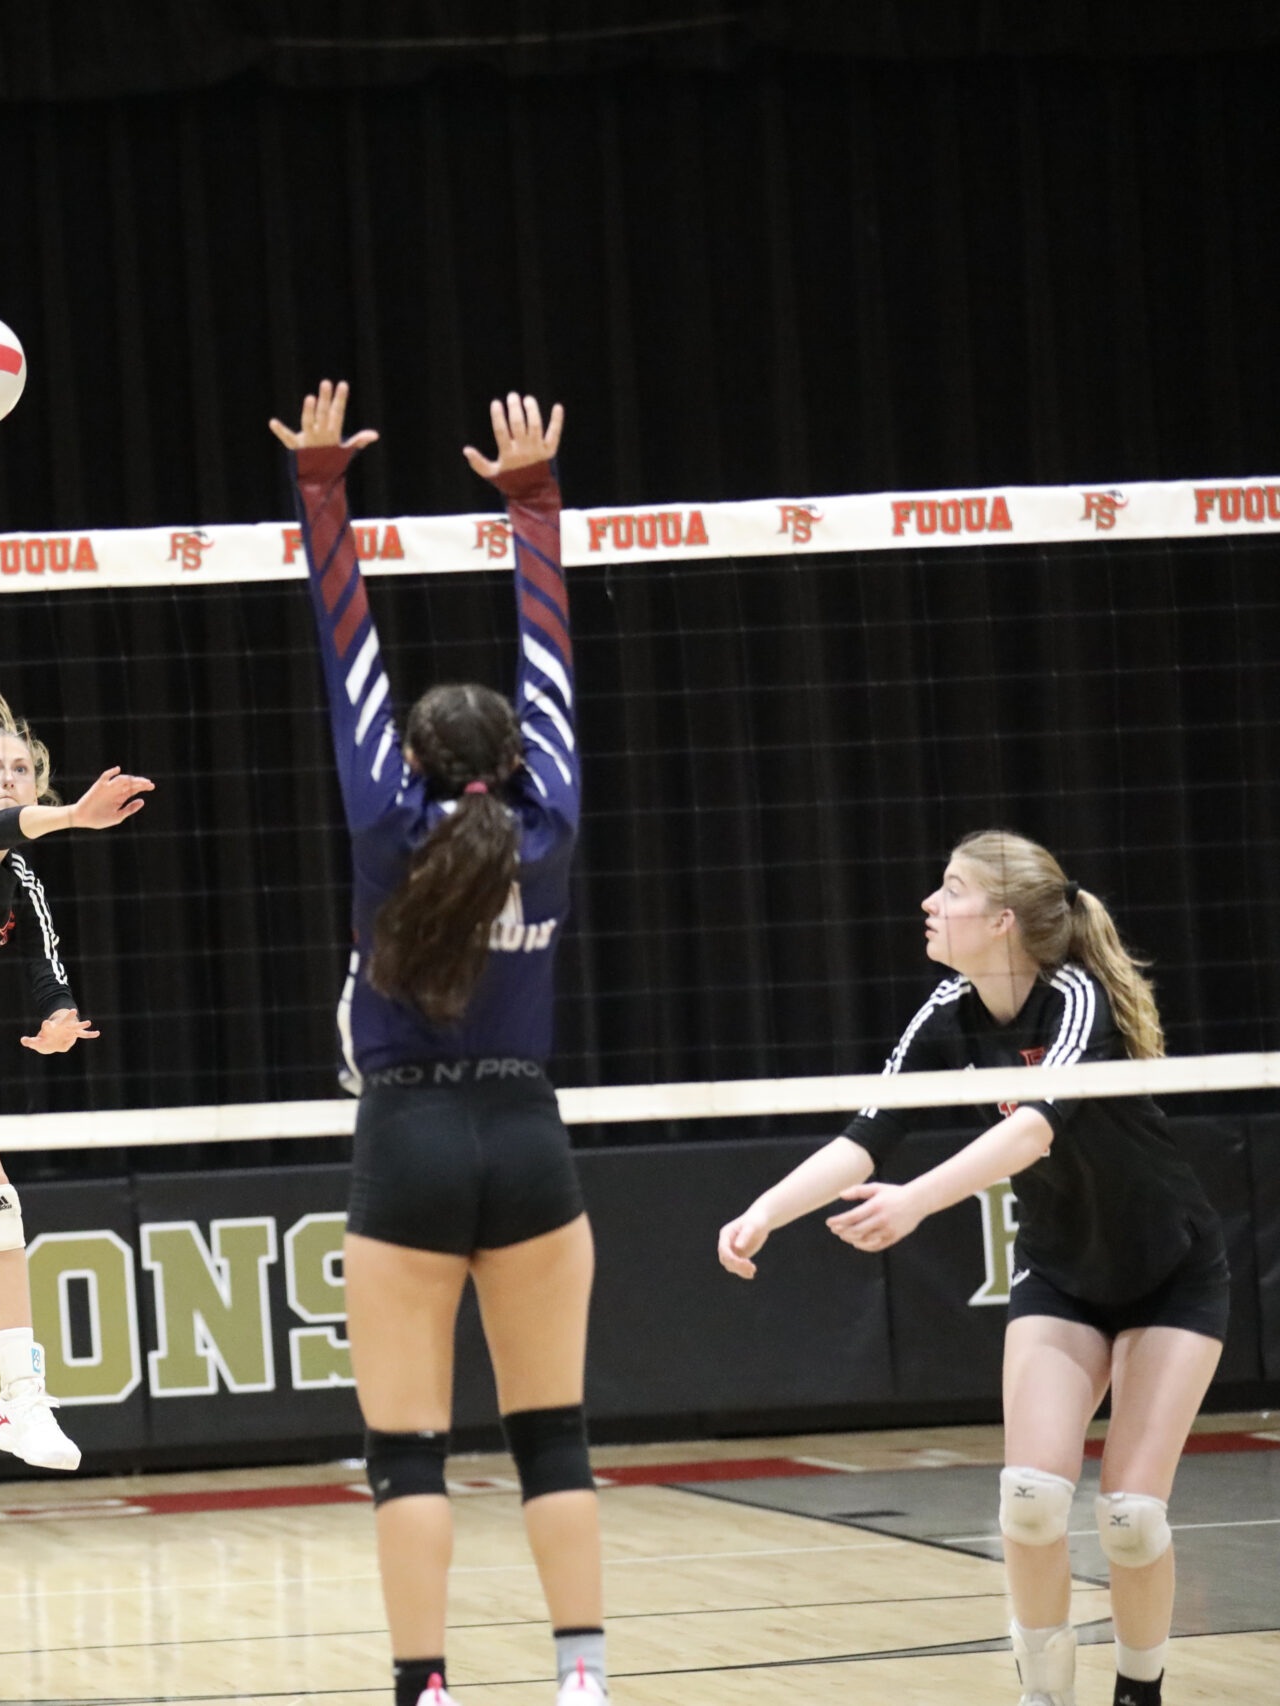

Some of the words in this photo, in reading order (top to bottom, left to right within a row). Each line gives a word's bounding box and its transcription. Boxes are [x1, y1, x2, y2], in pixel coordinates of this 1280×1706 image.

[281, 524, 406, 565] FUA
[587, 510, 710, 552] FUQUA
[891, 495, 1013, 536] FUQUA
